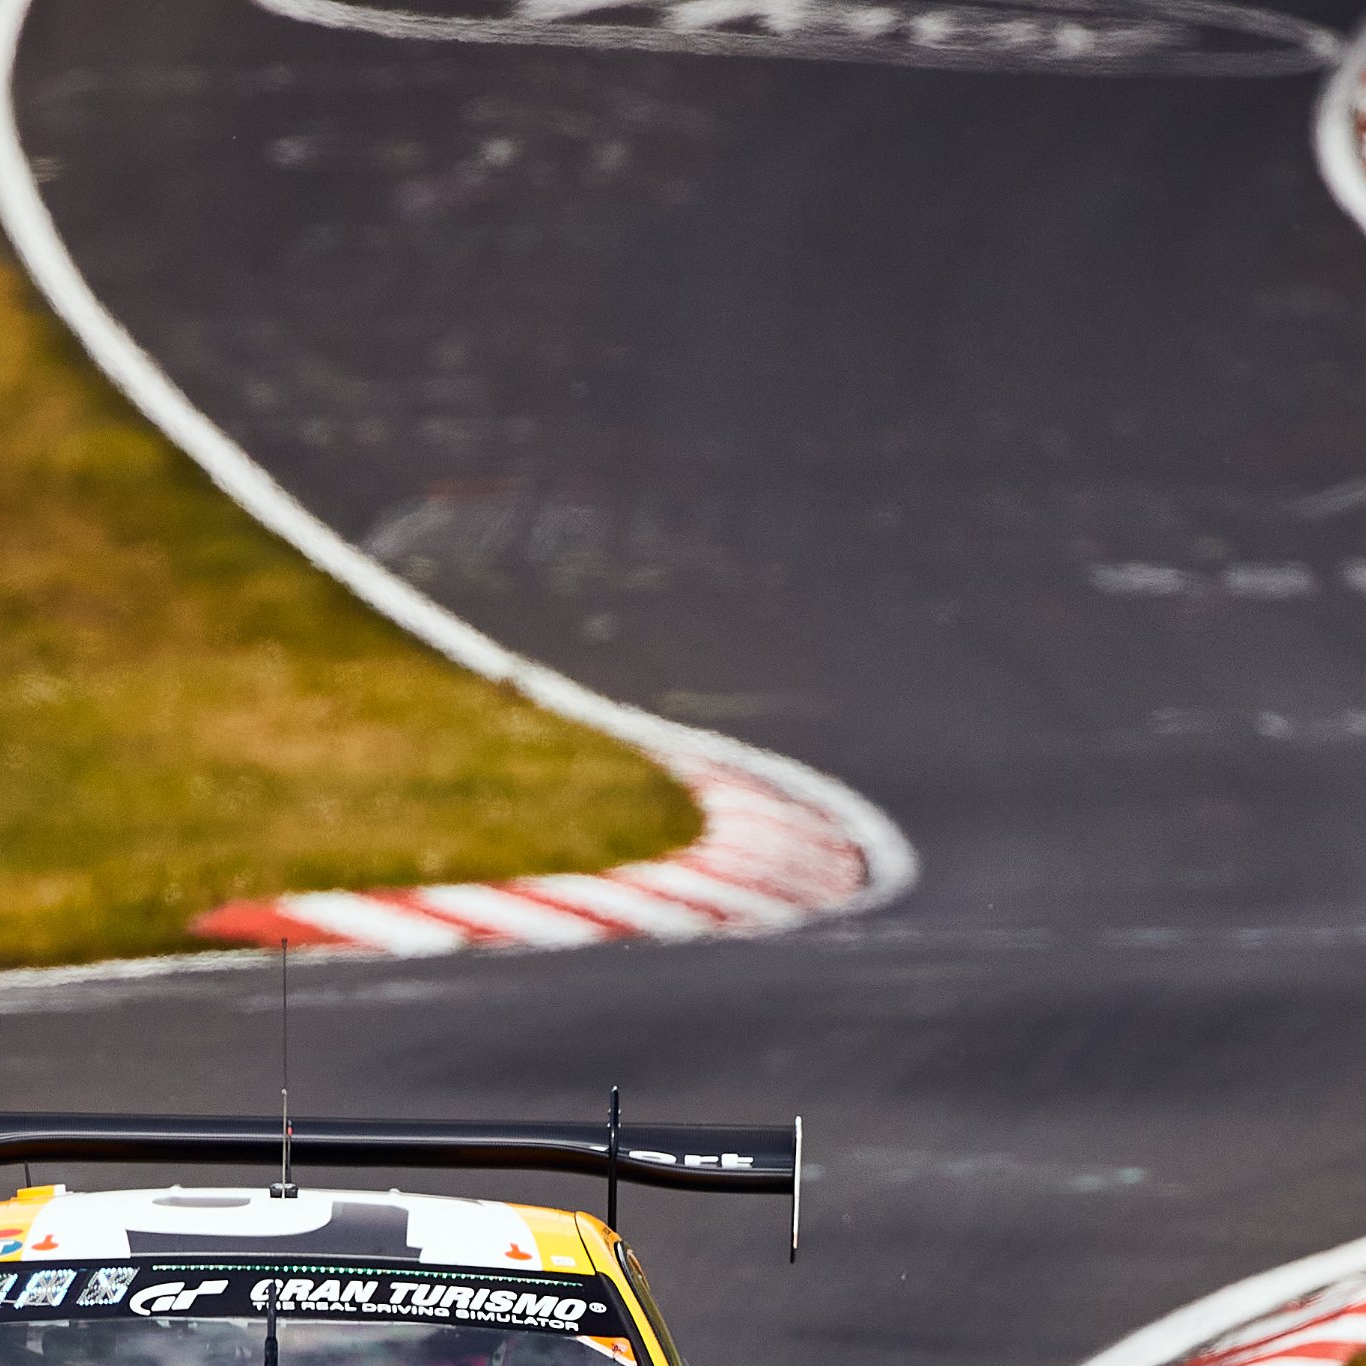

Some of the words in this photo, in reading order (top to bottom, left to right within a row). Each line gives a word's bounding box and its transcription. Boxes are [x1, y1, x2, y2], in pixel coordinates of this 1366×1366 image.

[249, 1278, 387, 1304] GRAN
[300, 1301, 358, 1313] REAL
[361, 1302, 450, 1318] DRIVING
[455, 1308, 580, 1332] SIMULATOR
